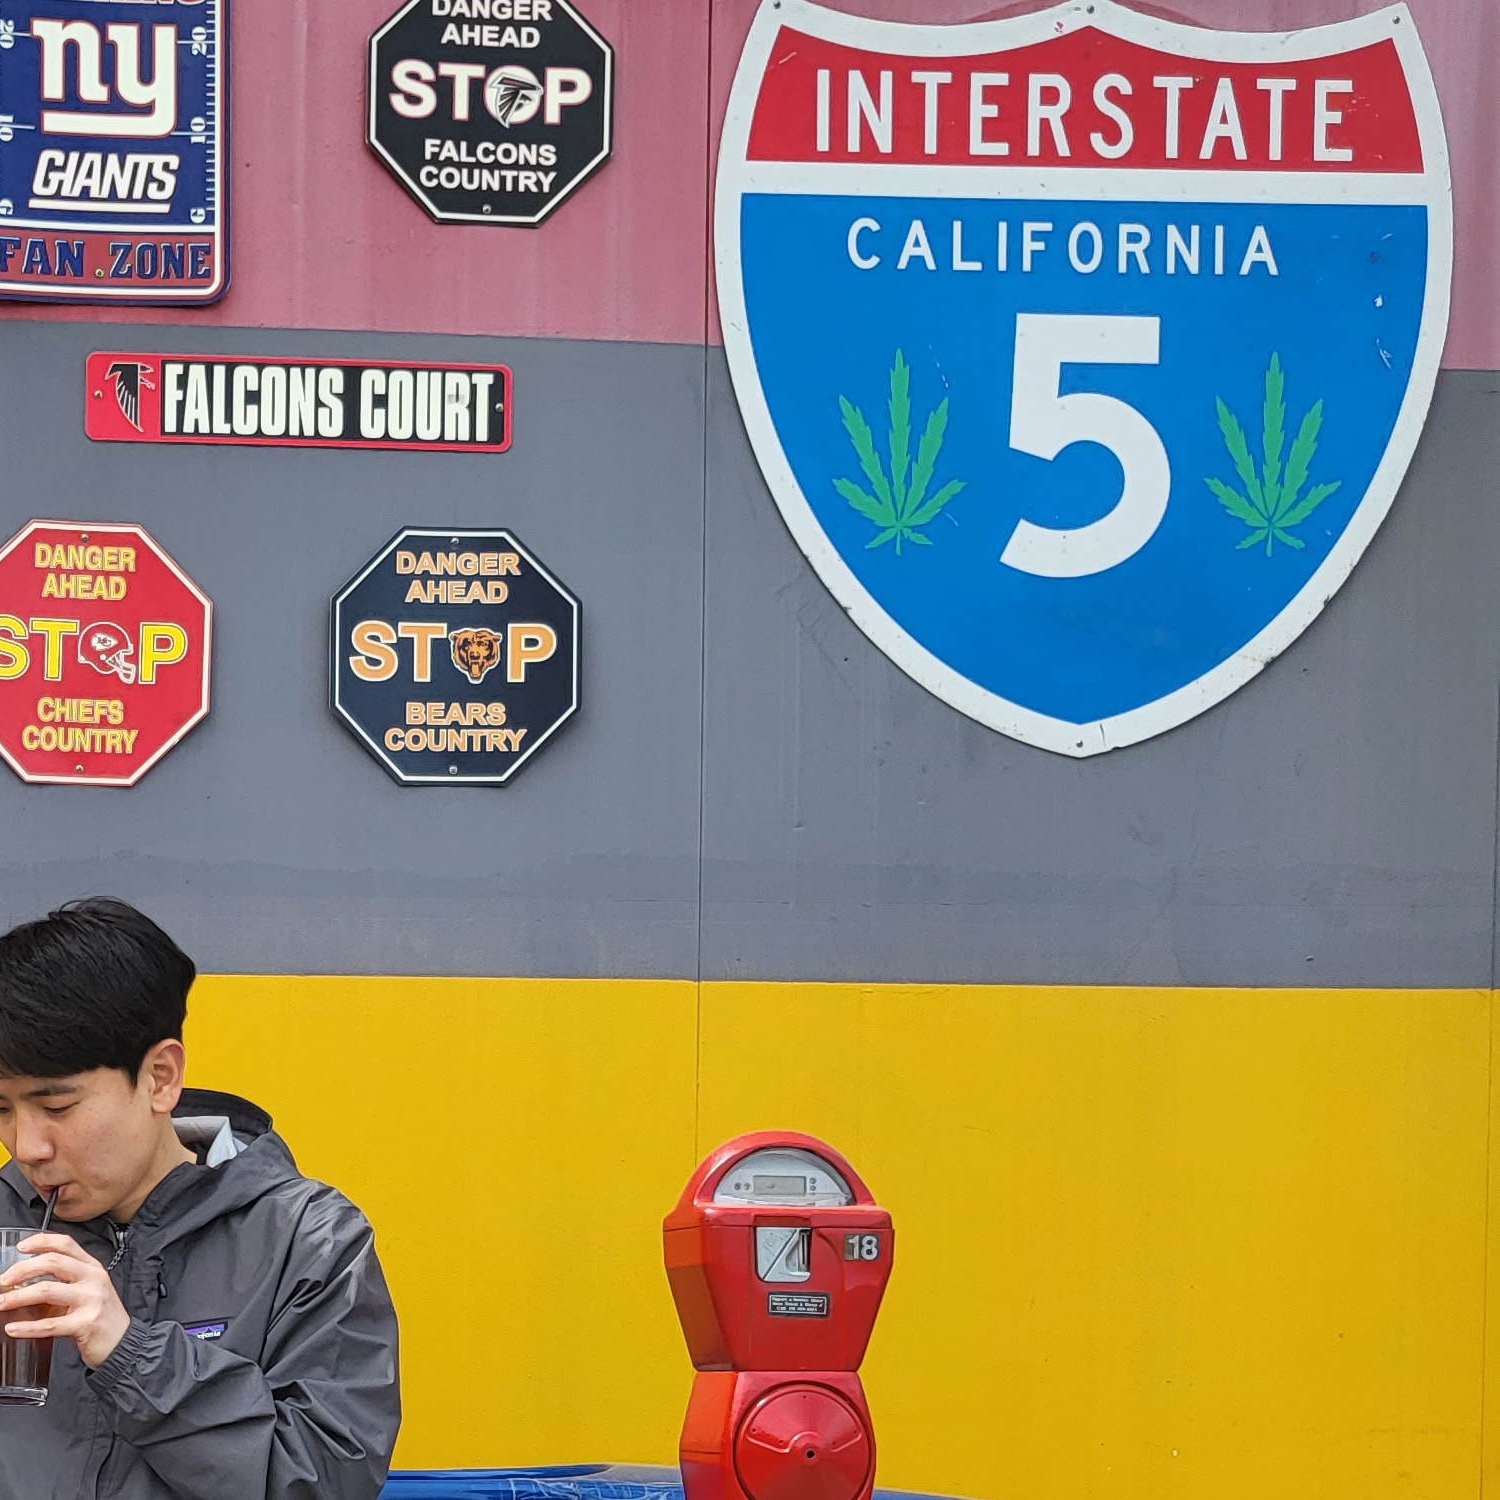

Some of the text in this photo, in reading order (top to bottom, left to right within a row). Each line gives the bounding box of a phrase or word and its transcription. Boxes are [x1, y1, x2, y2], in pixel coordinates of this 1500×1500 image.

[432, 0, 553, 21] DANGER
[441, 22, 541, 49] AHEAD
[389, 58, 593, 126] STOP
[816, 68, 1355, 162] INTERSTATE
[423, 138, 558, 166] FALCONS
[31, 148, 181, 200] GIANTS
[419, 165, 558, 193] COUNTRY
[846, 216, 1280, 276] CALIFORNIA
[109, 242, 211, 280] ZONE
[163, 363, 495, 442] FALCONS COURT
[999, 313, 1172, 578] 5
[34, 542, 137, 572] DANGER
[396, 552, 522, 576] DANGER
[41, 573, 127, 600] AHEAD
[404, 580, 509, 604] AHEAD
[349, 620, 556, 684] STP
[37, 696, 124, 725] CHIEFS
[405, 701, 507, 726] BEARS
[21, 725, 139, 754] COUNTRY
[384, 728, 528, 752] COUNTRY
[847, 1234, 878, 1260] 18
